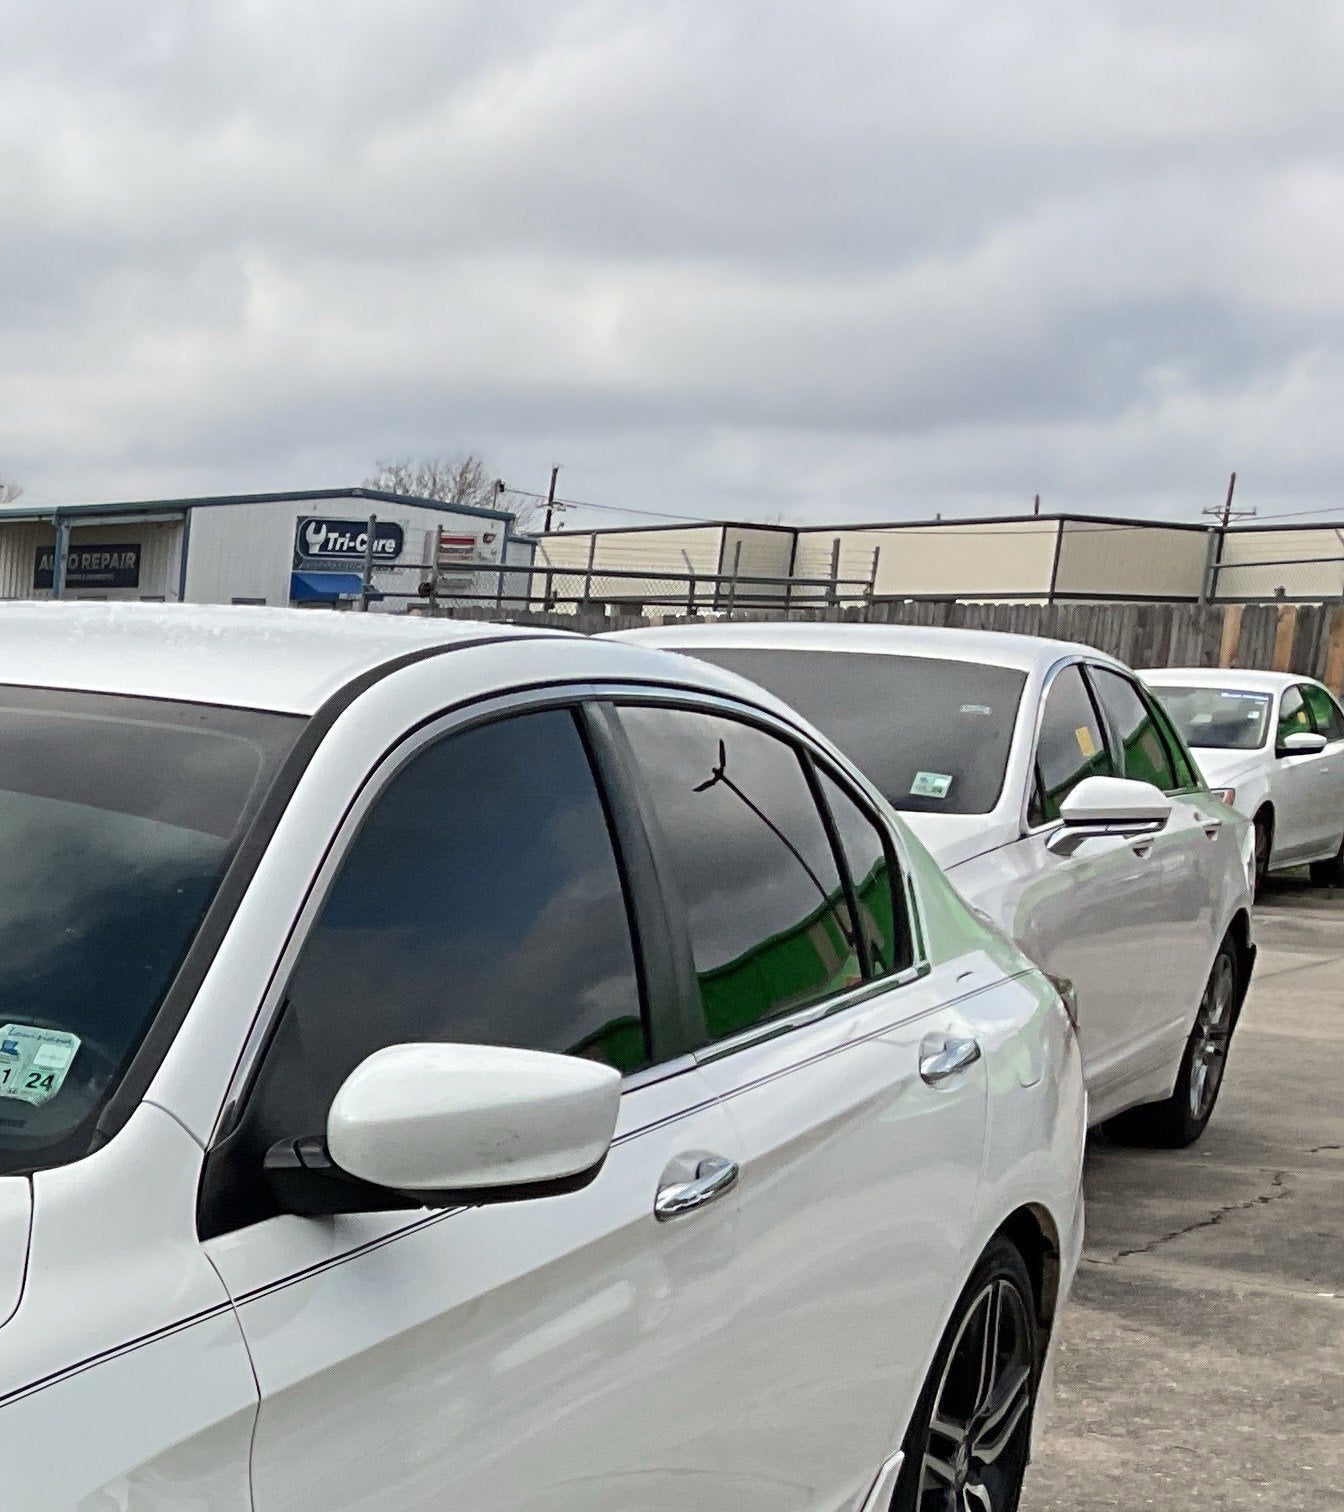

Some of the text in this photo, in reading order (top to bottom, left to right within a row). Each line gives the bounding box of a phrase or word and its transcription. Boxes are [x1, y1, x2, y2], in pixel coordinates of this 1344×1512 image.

[39, 552, 137, 571] AO REPAIR
[25, 1072, 55, 1092] 24
